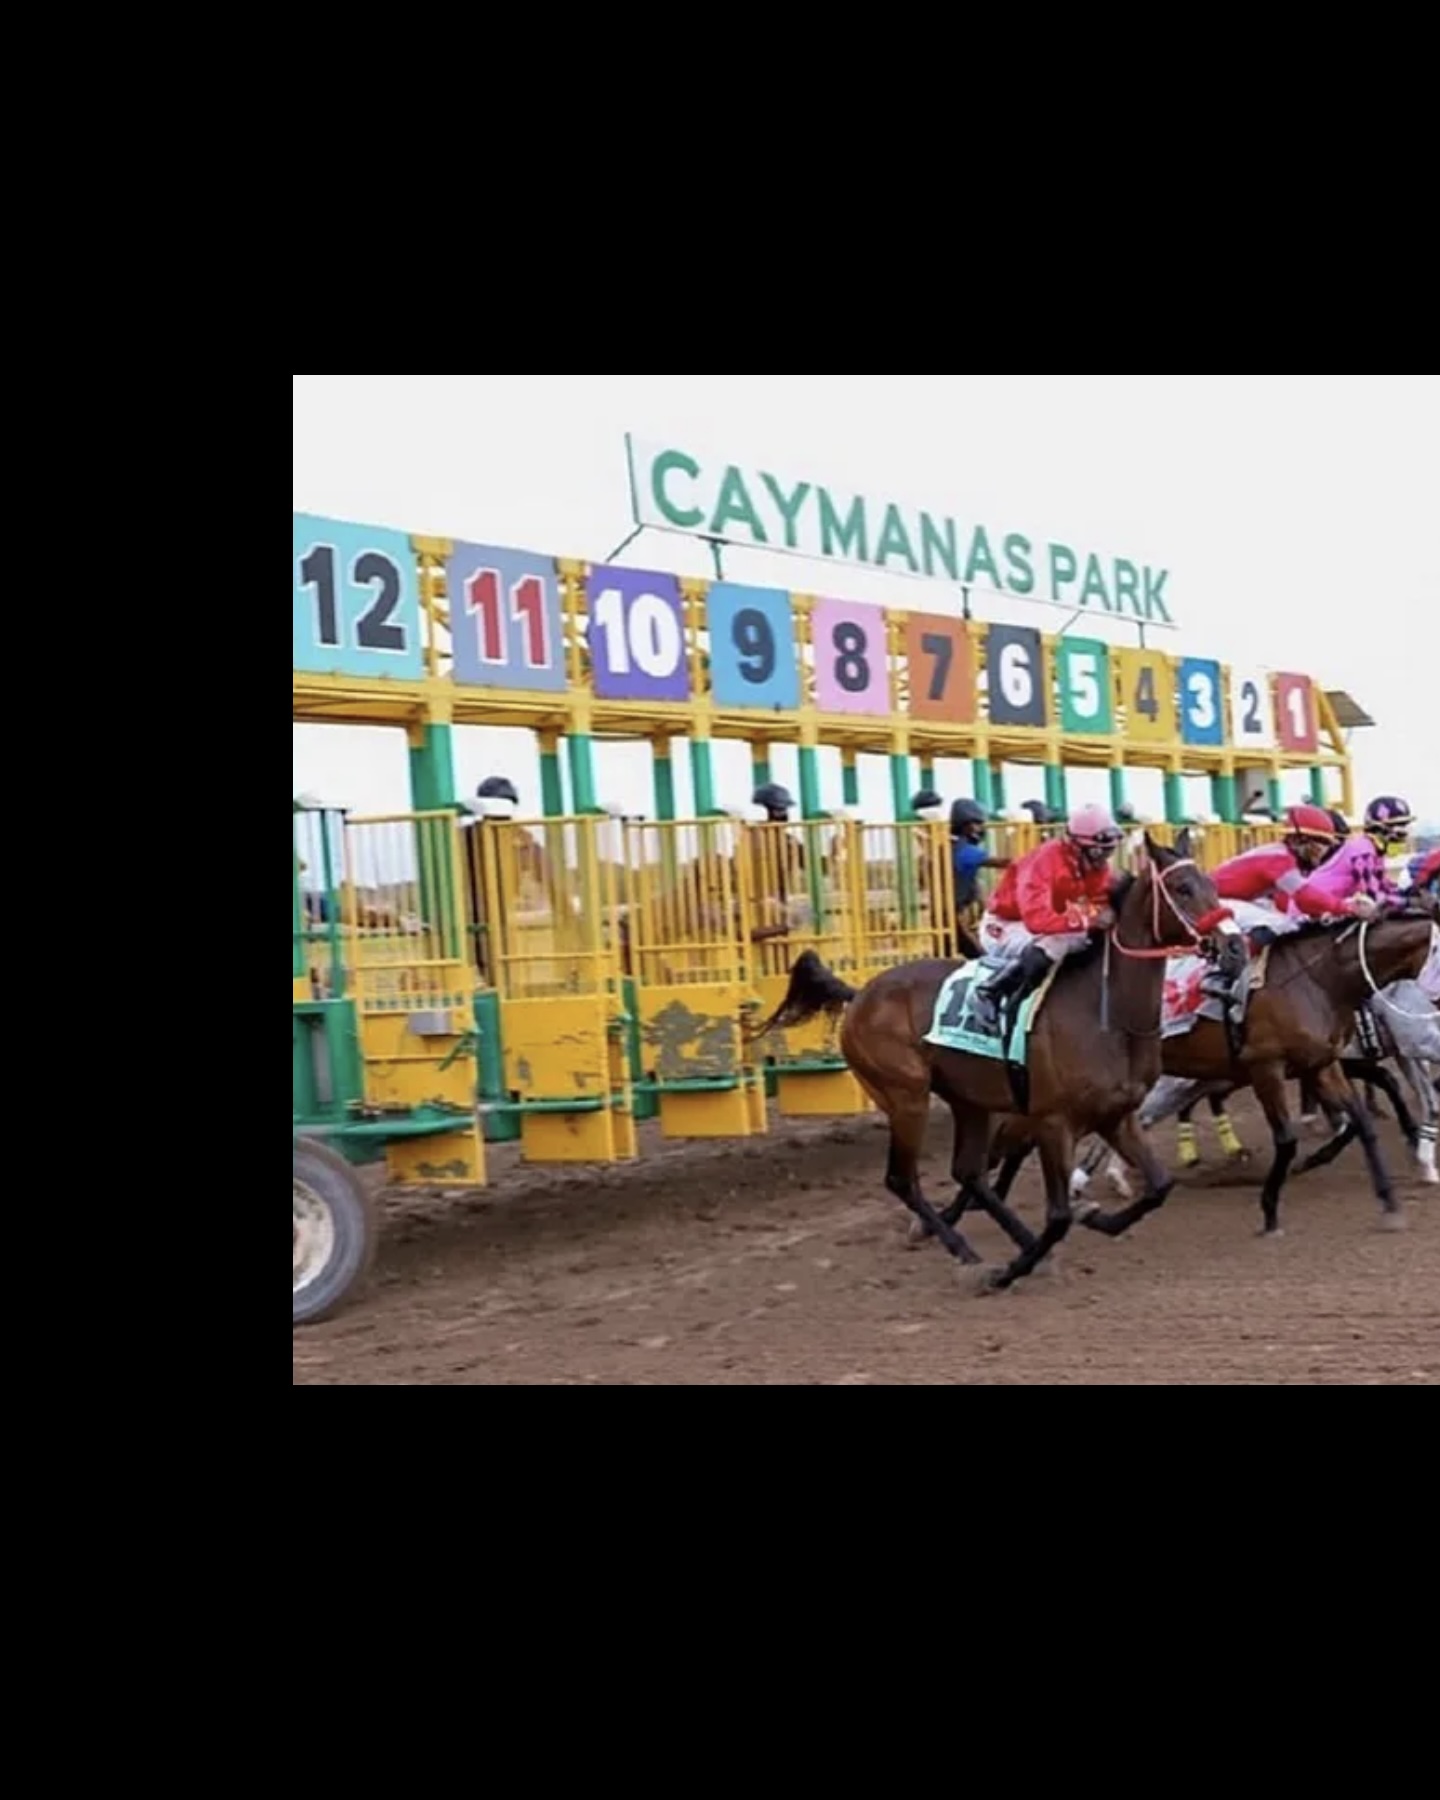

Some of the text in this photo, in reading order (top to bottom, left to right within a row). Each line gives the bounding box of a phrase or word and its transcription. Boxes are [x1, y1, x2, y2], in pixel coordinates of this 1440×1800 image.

[651, 449, 1173, 622] CAYMANAS PARK
[298, 540, 409, 653] 12
[464, 566, 553, 669] 11
[594, 588, 683, 678] 10
[731, 607, 776, 684] 9
[832, 621, 871, 693] 8
[921, 633, 954, 701] 7
[1000, 642, 1033, 708] 6
[1066, 651, 1099, 718] 5
[1135, 666, 1158, 722] 4
[1188, 671, 1215, 729] 3
[1243, 680, 1263, 733] 2
[1285, 687, 1306, 740] 1
